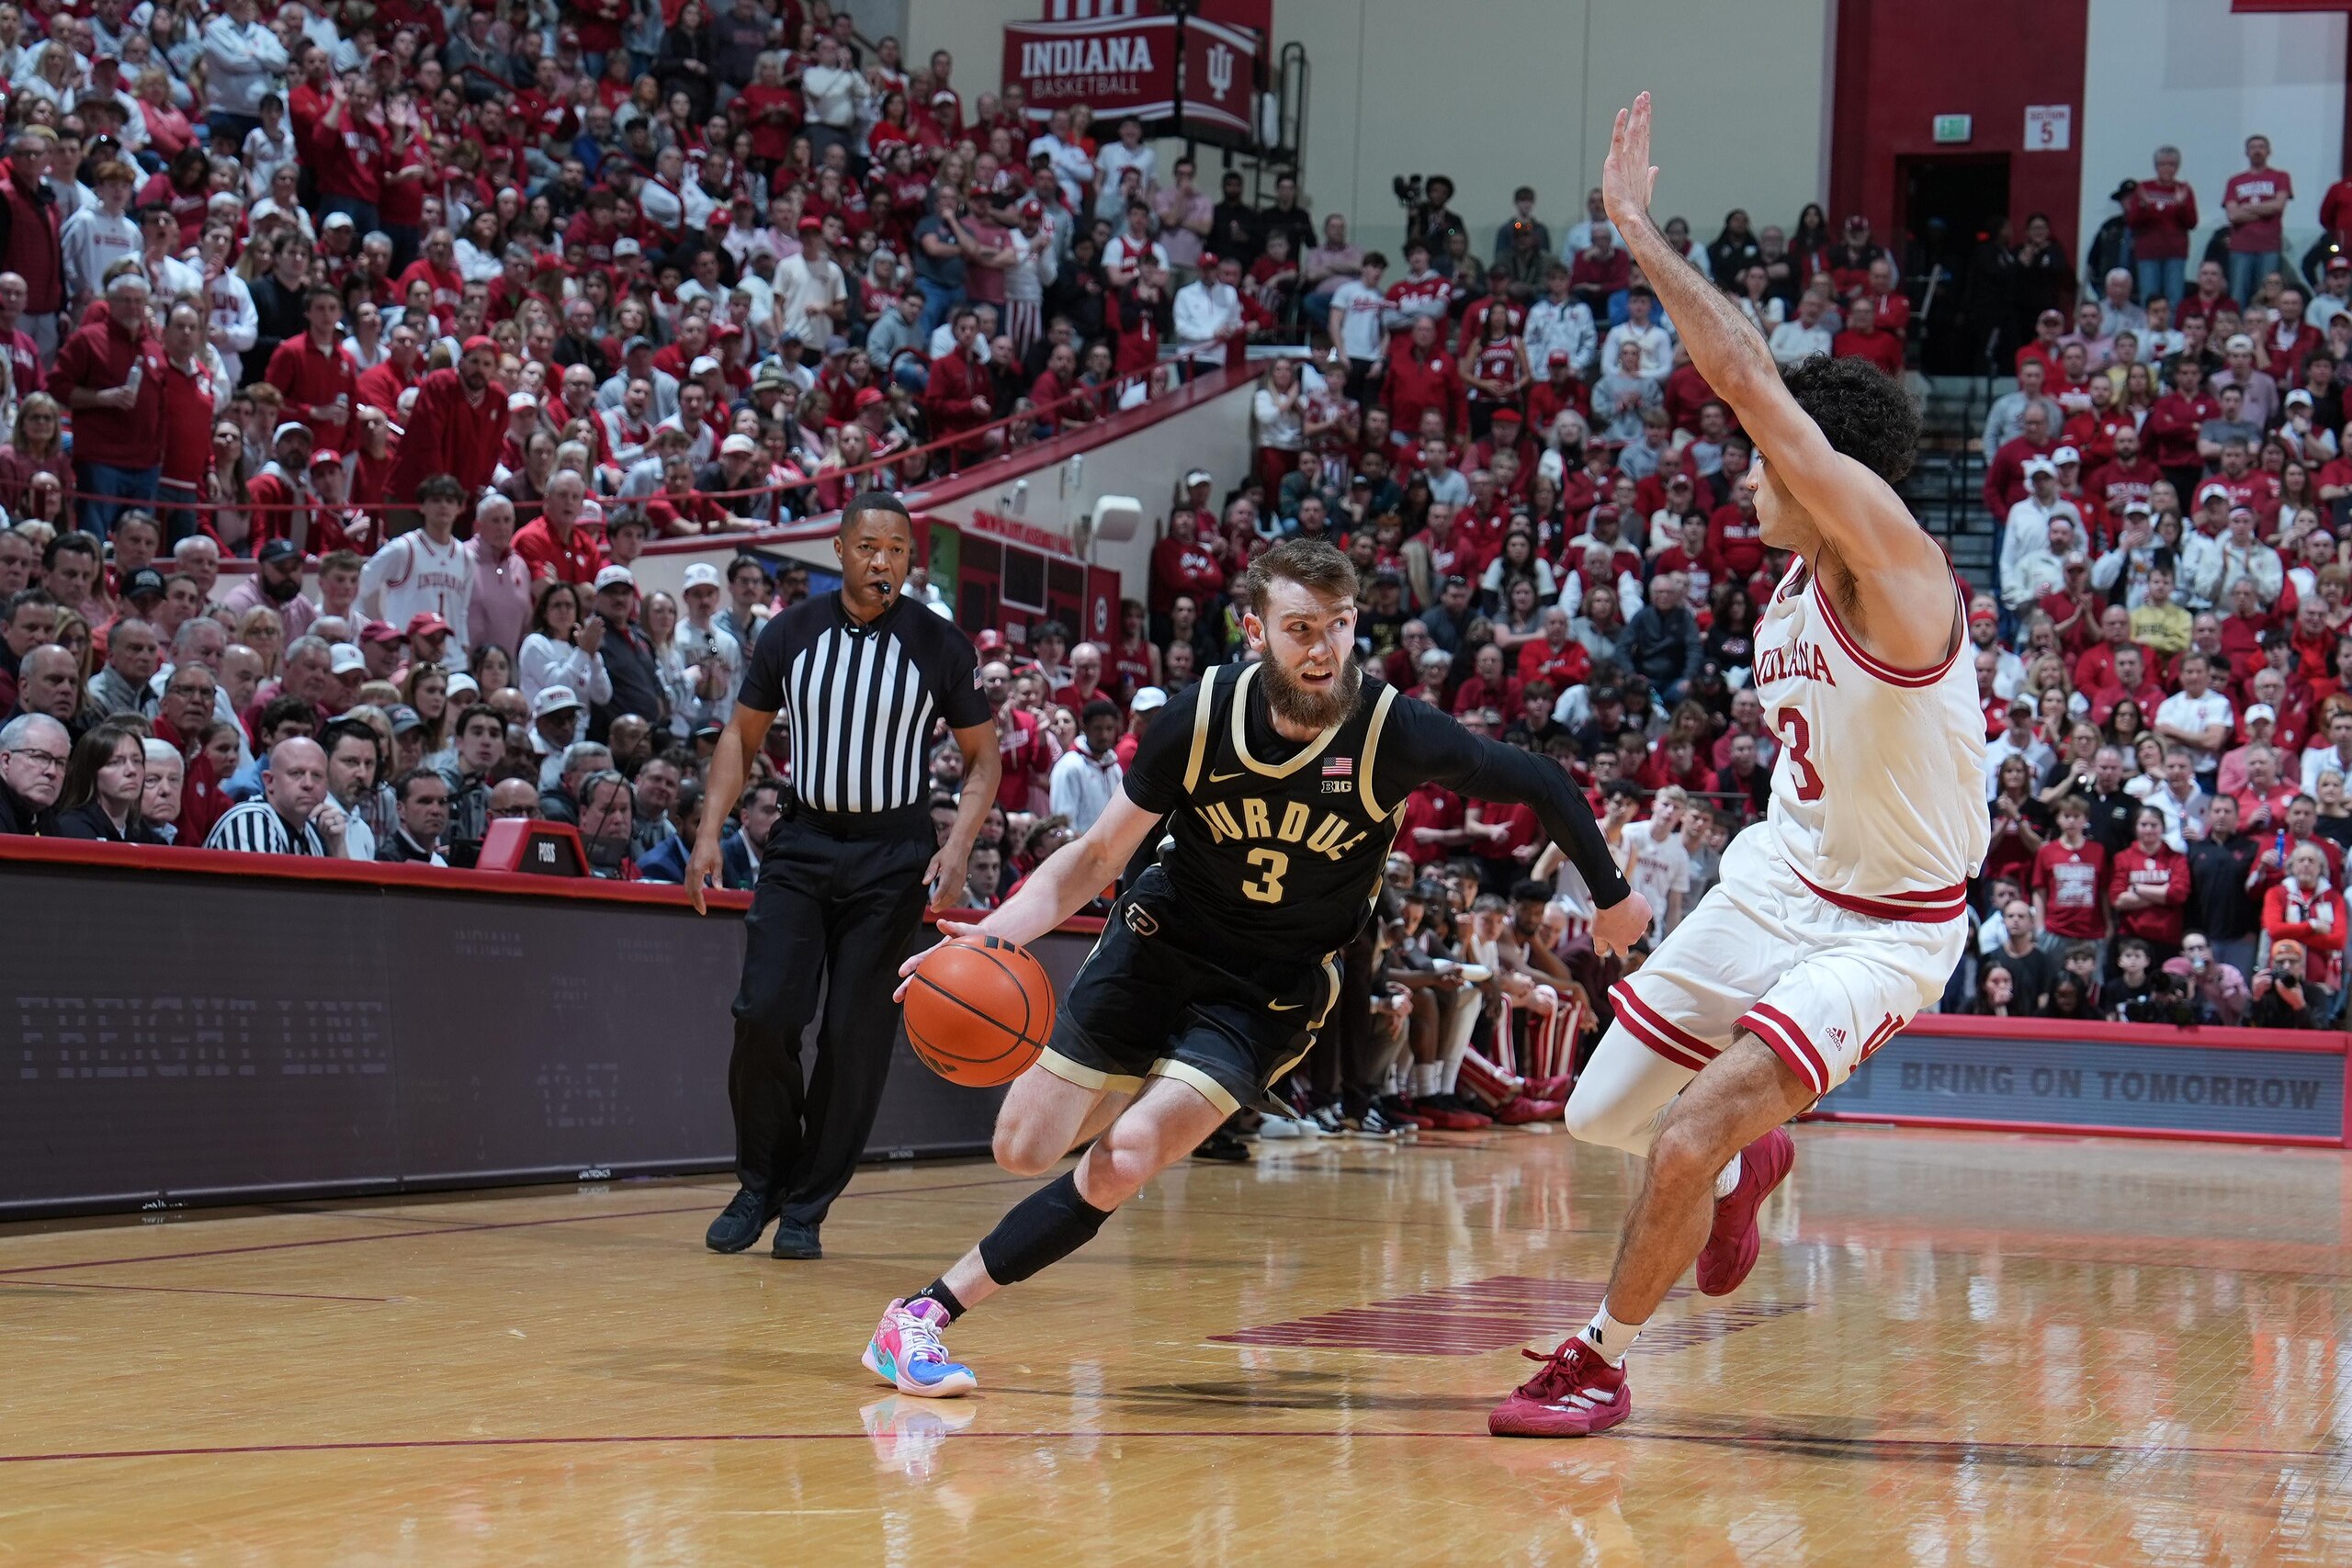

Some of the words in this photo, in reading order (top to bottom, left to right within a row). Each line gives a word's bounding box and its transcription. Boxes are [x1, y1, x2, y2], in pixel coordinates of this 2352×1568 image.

[1020, 36, 1154, 78] INDIANA
[1031, 75, 1139, 98] BASKETBALL
[2041, 121, 2053, 143] 5
[1778, 707, 1825, 800] 3
[537, 841, 556, 863] POSS
[1242, 847, 1289, 904] 3
[16, 997, 256, 1079] FREIGHT
[1826, 1027, 1843, 1051] adidas
[1901, 1062, 2013, 1092] BRING
[2030, 1066, 2082, 1098] ON
[2098, 1070, 2322, 1110] TOMORROW
